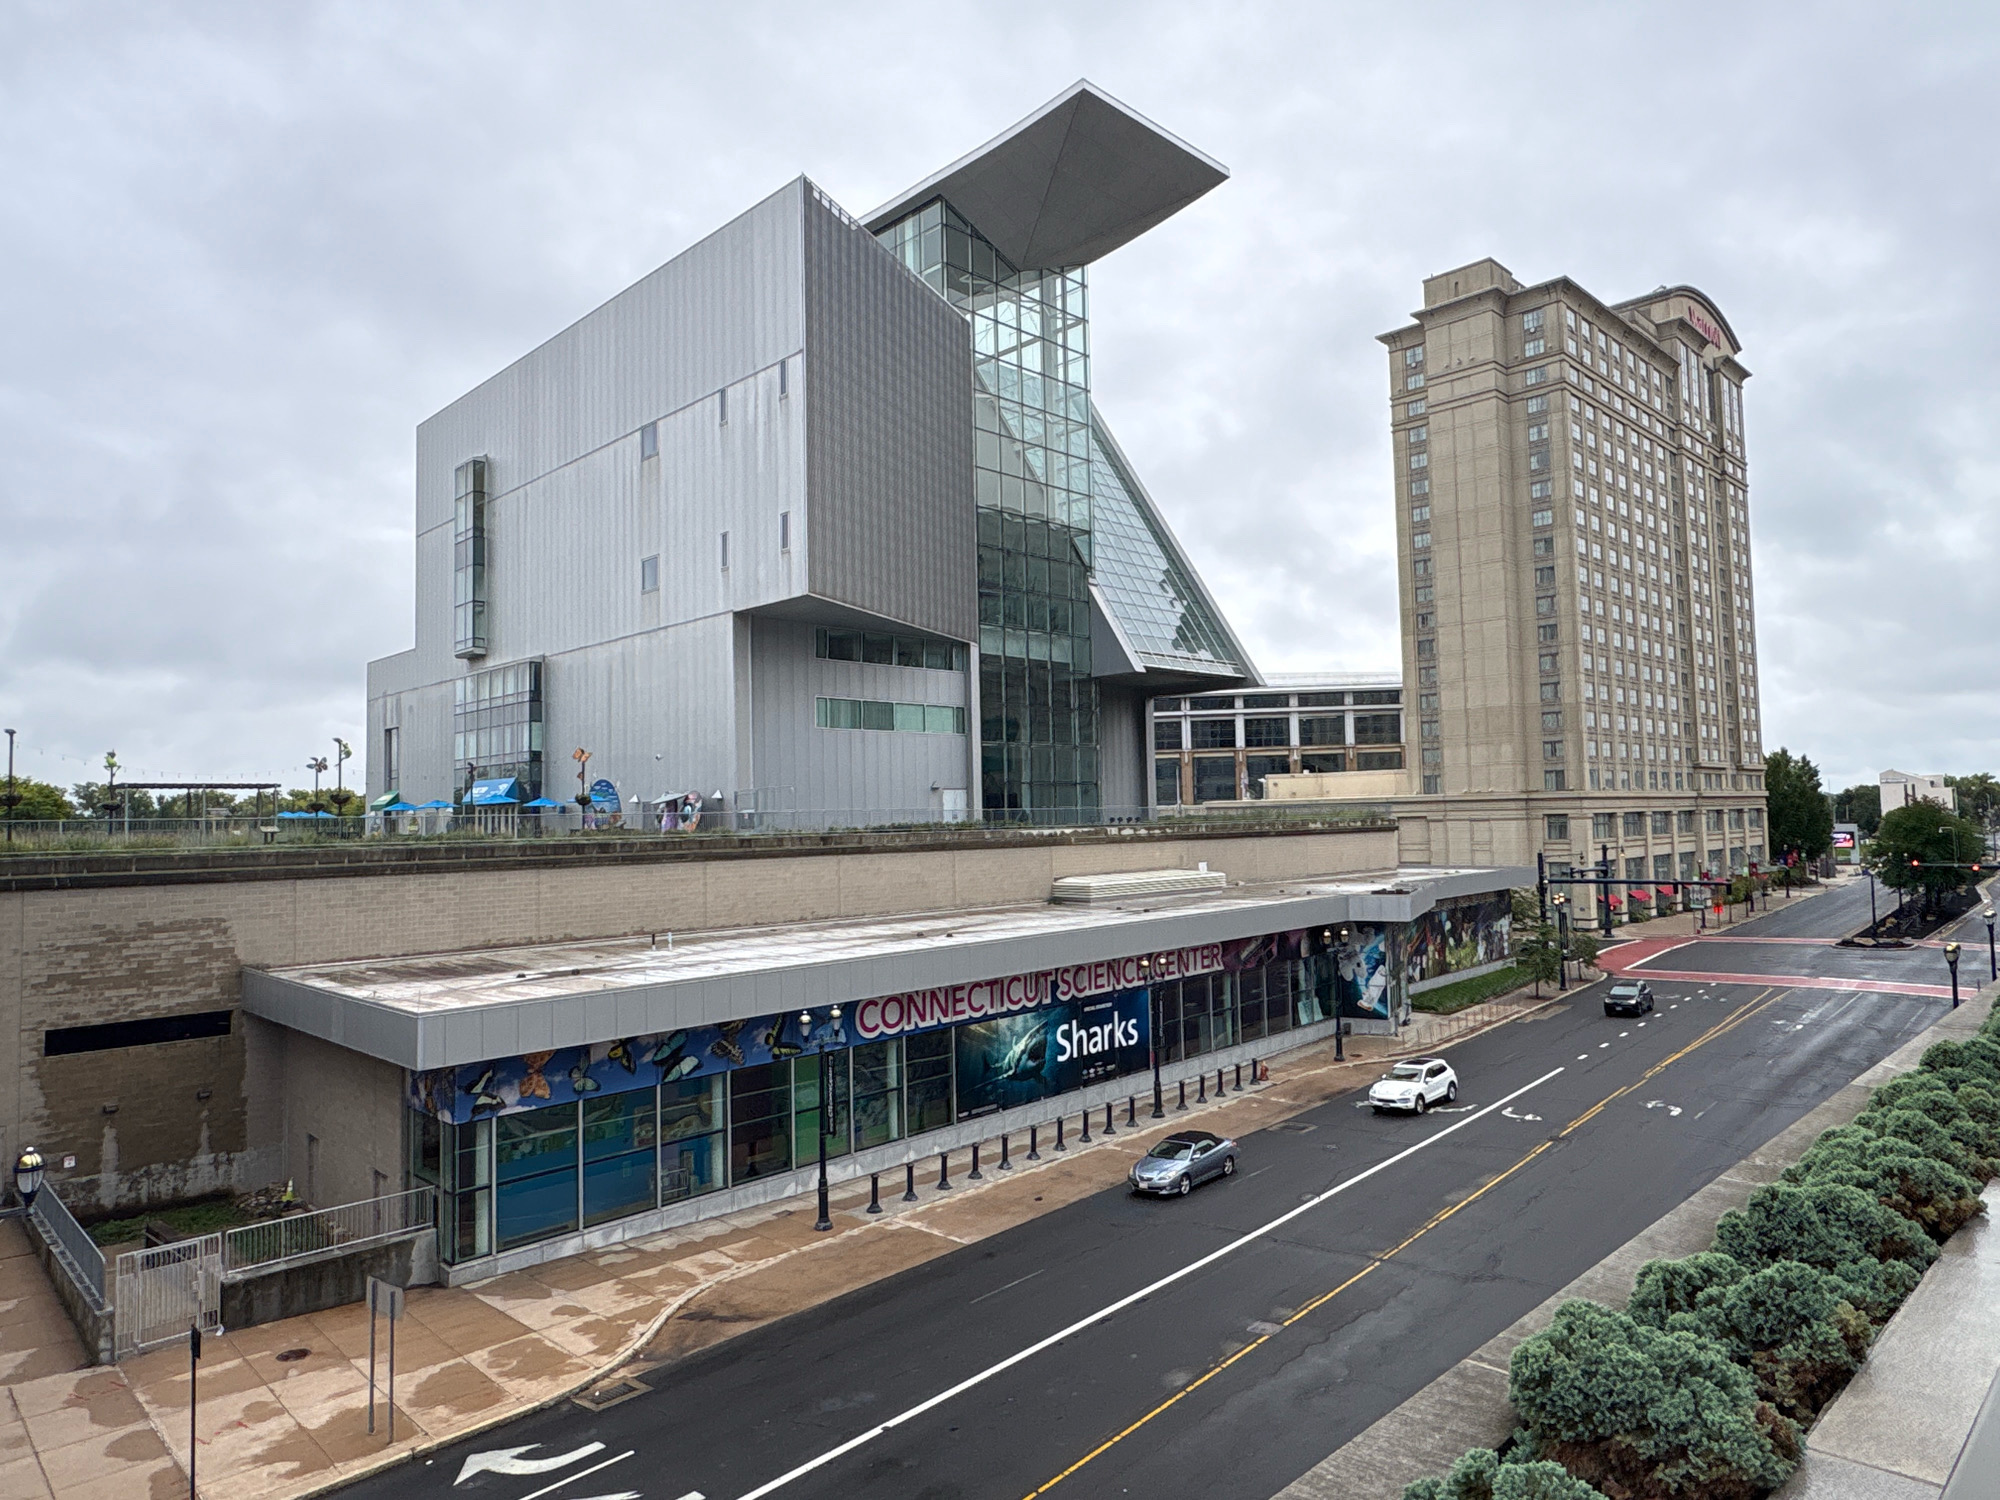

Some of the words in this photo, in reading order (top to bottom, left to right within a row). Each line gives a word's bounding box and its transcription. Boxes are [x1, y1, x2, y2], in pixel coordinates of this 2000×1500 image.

[858, 970, 1053, 1033] CONNECTICUT
[1059, 955, 1148, 997] SCIENCE
[1152, 943, 1223, 979] CENTER
[1056, 1010, 1139, 1063] Sharks
